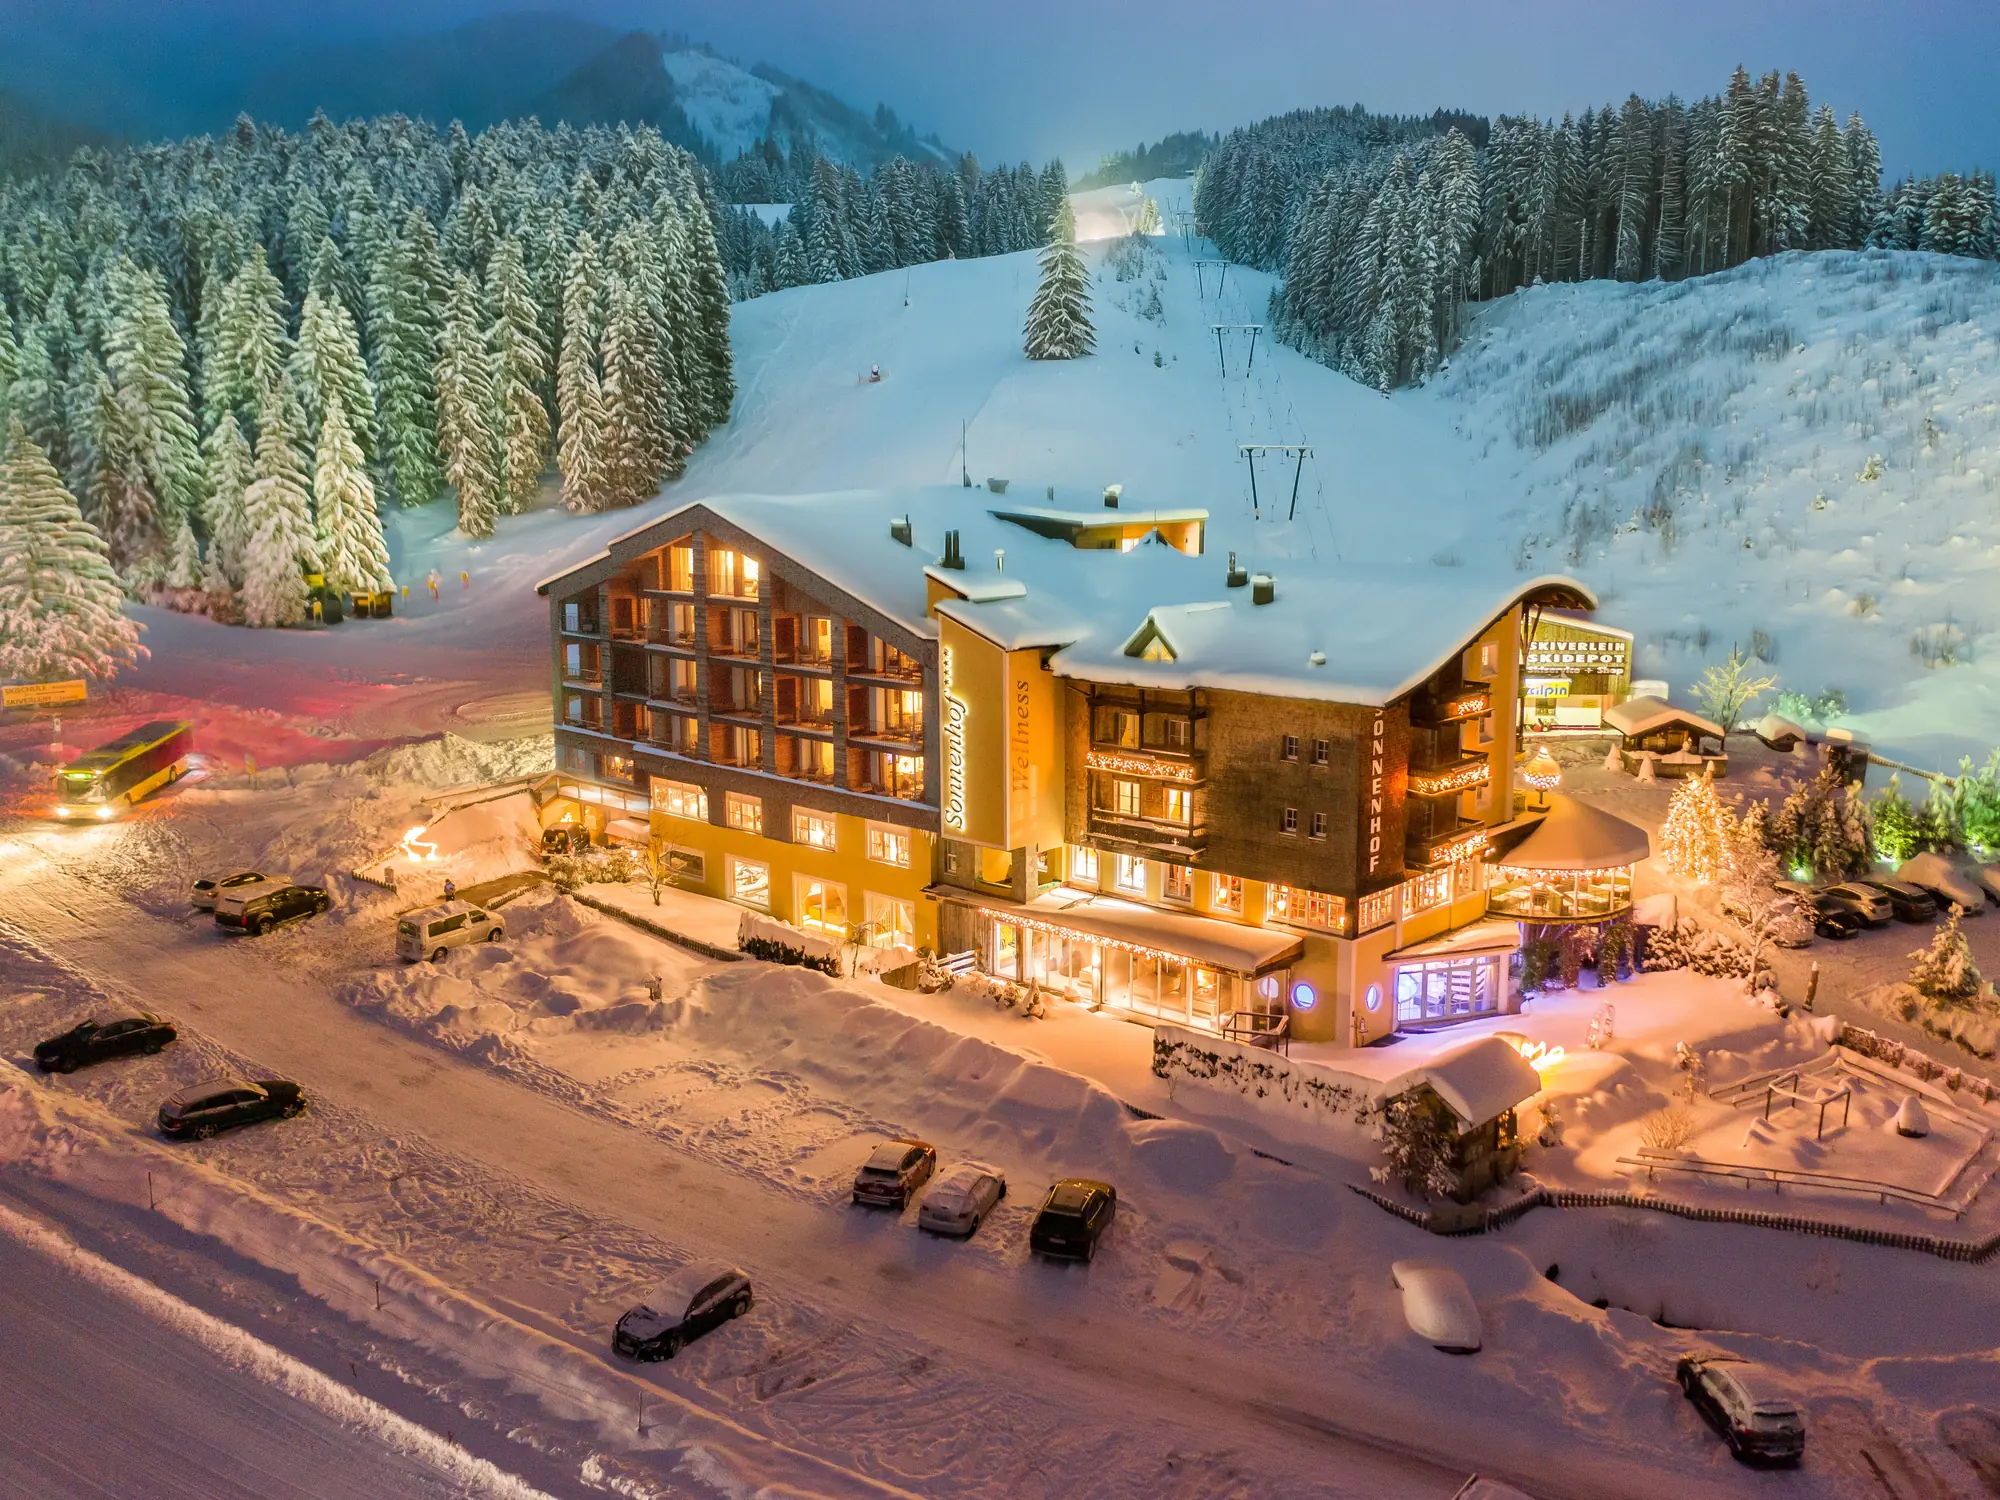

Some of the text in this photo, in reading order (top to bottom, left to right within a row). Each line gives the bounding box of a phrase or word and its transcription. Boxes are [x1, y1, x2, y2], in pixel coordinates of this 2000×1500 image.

[1529, 641, 1625, 651] SKIVERLEIH
[1527, 654, 1624, 663] SKIDEPOT
[1597, 666, 1624, 675] Shop
[1012, 680, 1029, 793] Wellness
[944, 690, 967, 829] Sonnenhof
